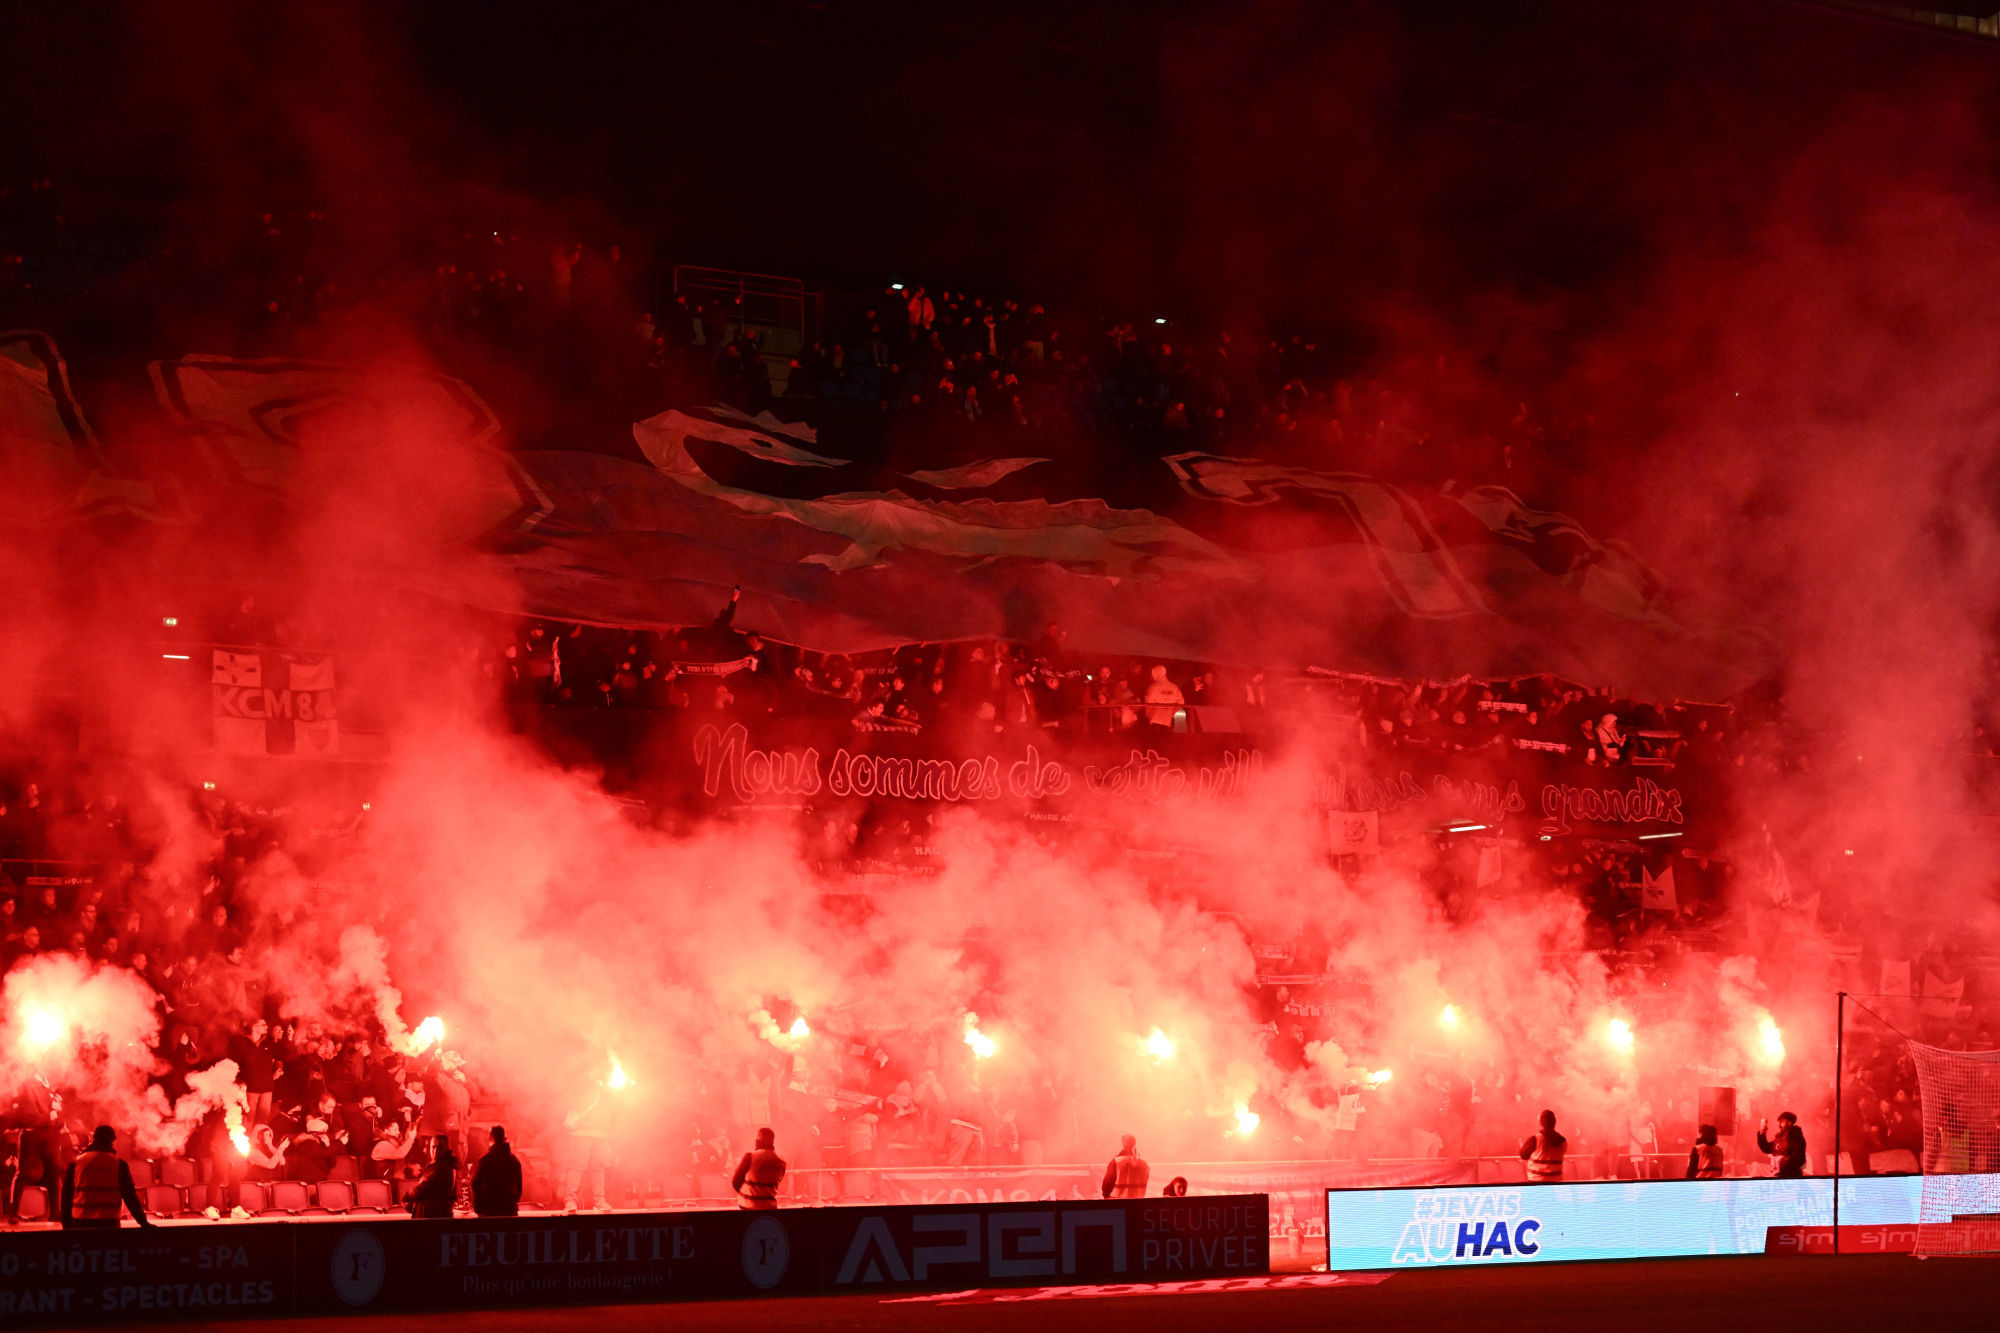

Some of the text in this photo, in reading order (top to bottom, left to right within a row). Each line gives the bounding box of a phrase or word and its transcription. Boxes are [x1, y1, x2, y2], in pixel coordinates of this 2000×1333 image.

[693, 722, 822, 801] Nous
[829, 747, 1003, 802] sommes
[1008, 743, 1071, 798] de
[1198, 748, 1266, 804] vill
[461, 1186, 471, 1208] HAC
[1413, 1191, 1522, 1220] #JEVAIS
[437, 1225, 696, 1268] FEUILLETTE
[1143, 1228, 1259, 1273] PRIVÉE
[1778, 1229, 1834, 1251] sjm
[1860, 1227, 1917, 1250] sjm
[47, 1242, 138, 1275] HÔTEL
[198, 1244, 250, 1270] SPA
[102, 1280, 275, 1311] SPECTACLES
[462, 1269, 499, 1293] Plus
